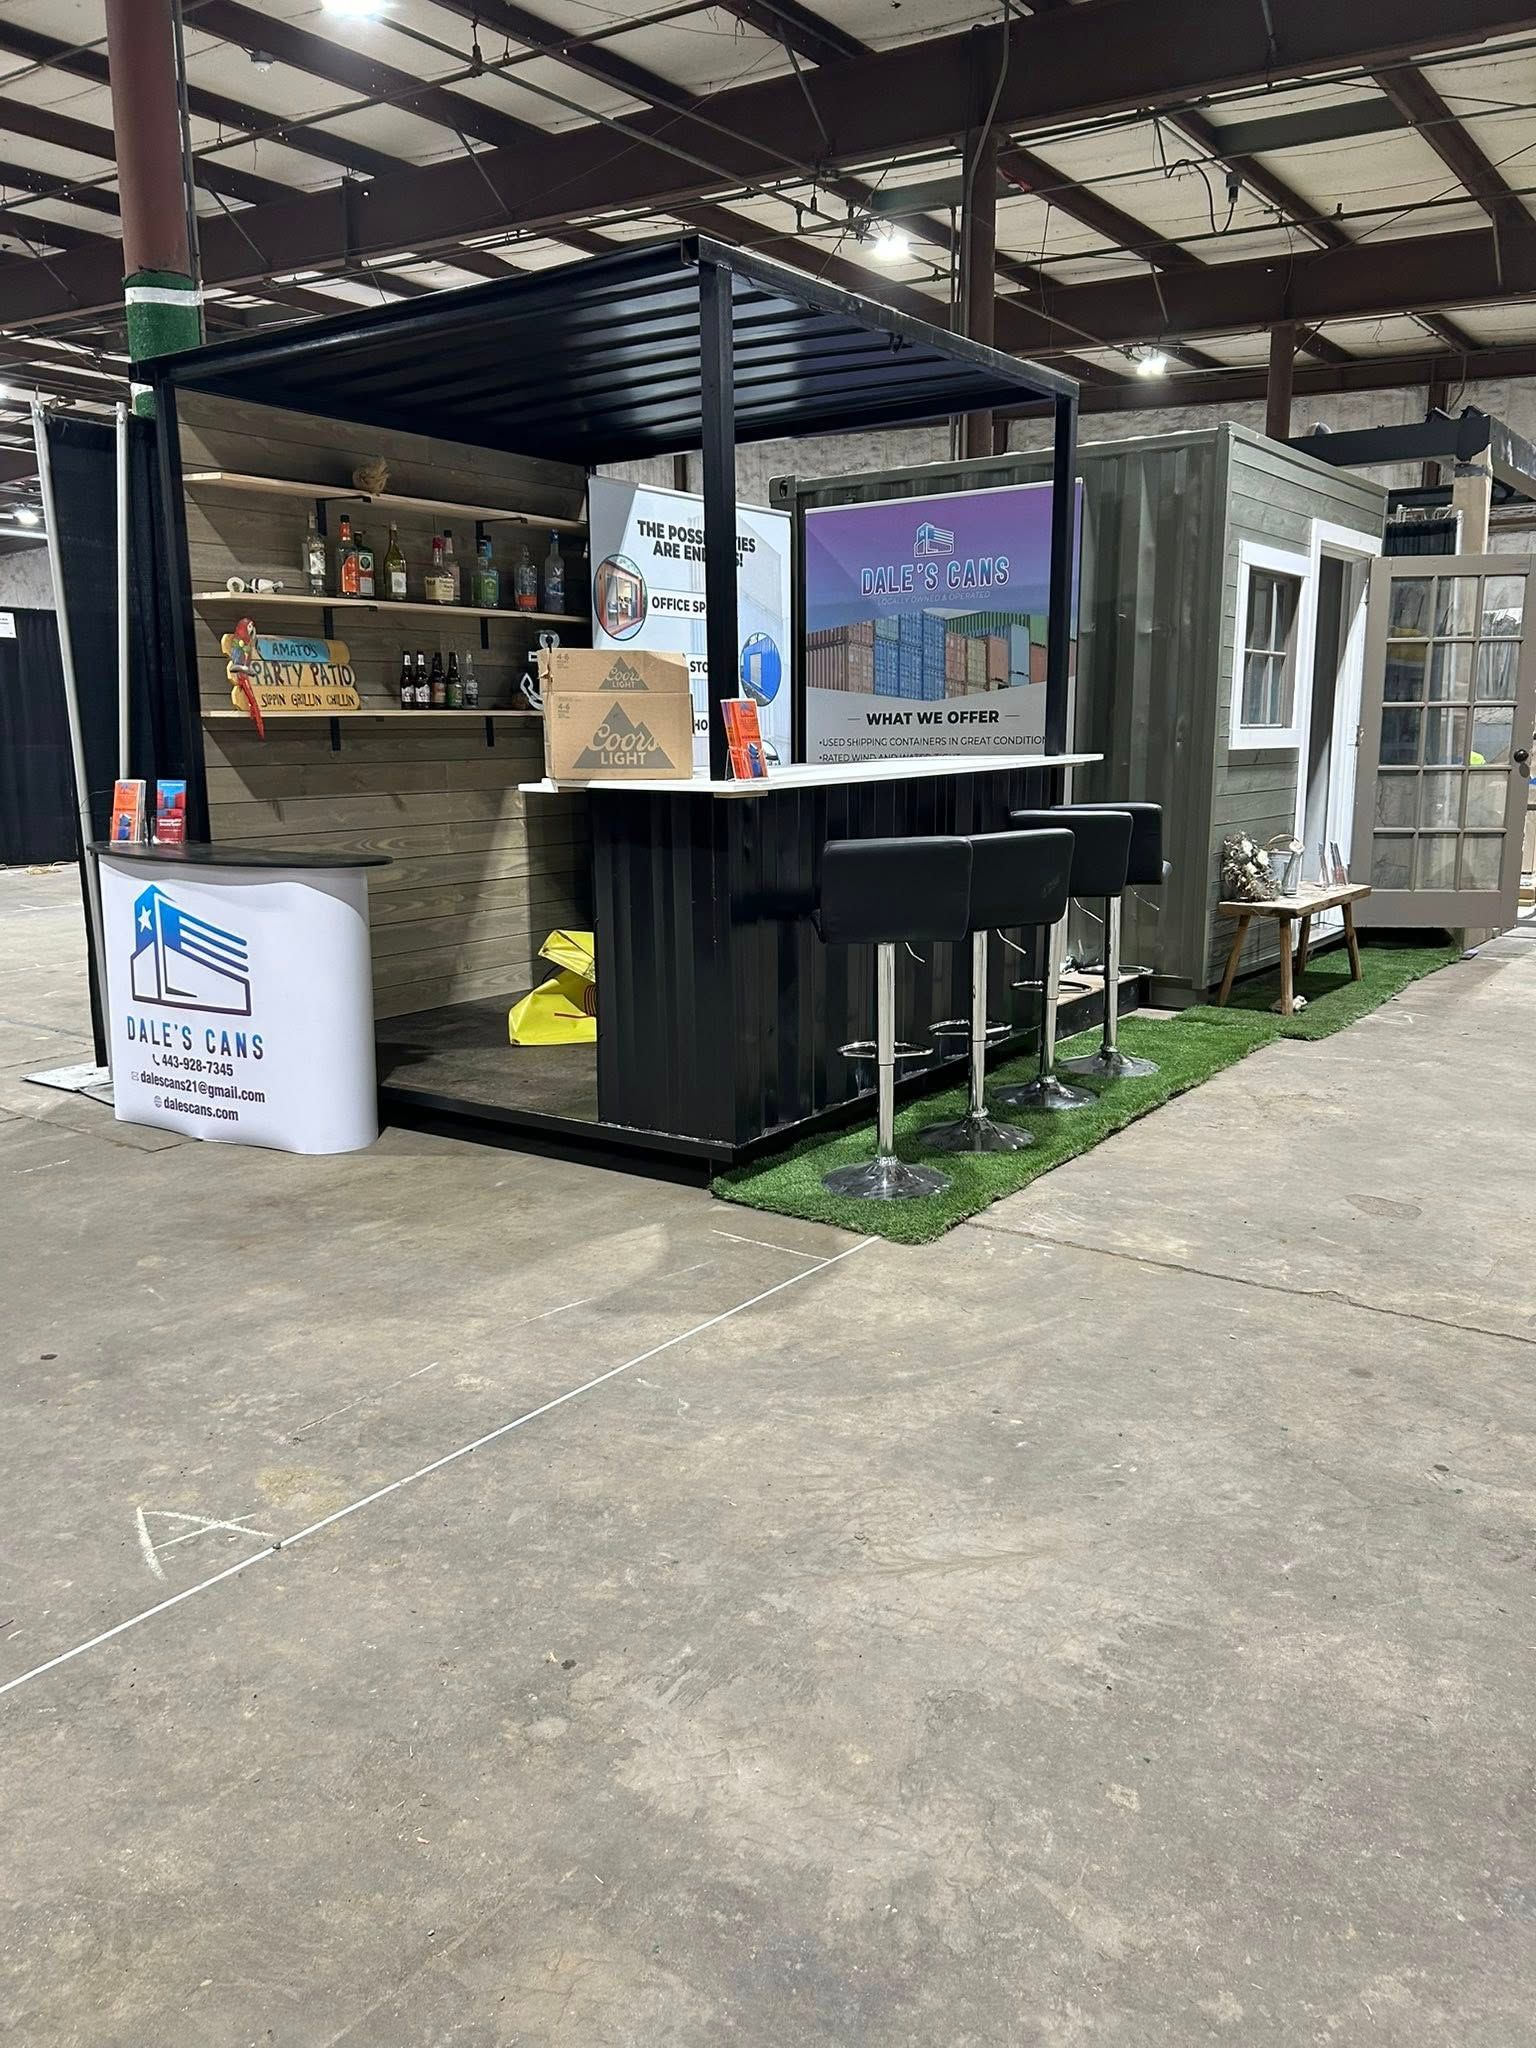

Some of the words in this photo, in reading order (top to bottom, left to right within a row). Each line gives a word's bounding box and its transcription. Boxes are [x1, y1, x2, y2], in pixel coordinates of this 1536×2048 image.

[637, 519, 665, 539] THE
[653, 540, 680, 559] ARE
[861, 562, 939, 595] DALE'S
[947, 557, 1009, 589] CANS
[652, 596, 690, 612] OFFICE
[949, 590, 991, 601] OPERATED
[252, 661, 302, 688] PARTY
[309, 662, 352, 687] PATIO
[606, 667, 641, 681] Coors
[866, 712, 912, 725] WHAT
[917, 711, 943, 724] WE
[947, 710, 999, 724] OFFER
[587, 723, 660, 751] Coors
[822, 738, 845, 747] USED
[847, 737, 887, 747] SHIPPING
[889, 737, 947, 746] CONTAINERS
[949, 737, 958, 745] IN
[961, 736, 991, 745] GREAT
[600, 752, 647, 765] LIGHT
[126, 1015, 192, 1050] DALE'S
[206, 1029, 264, 1060] CANS
[162, 1054, 234, 1077] 443-928-7345
[141, 1071, 266, 1103] dalescans21@gmail.com
[164, 1096, 239, 1121] dalescans.com
